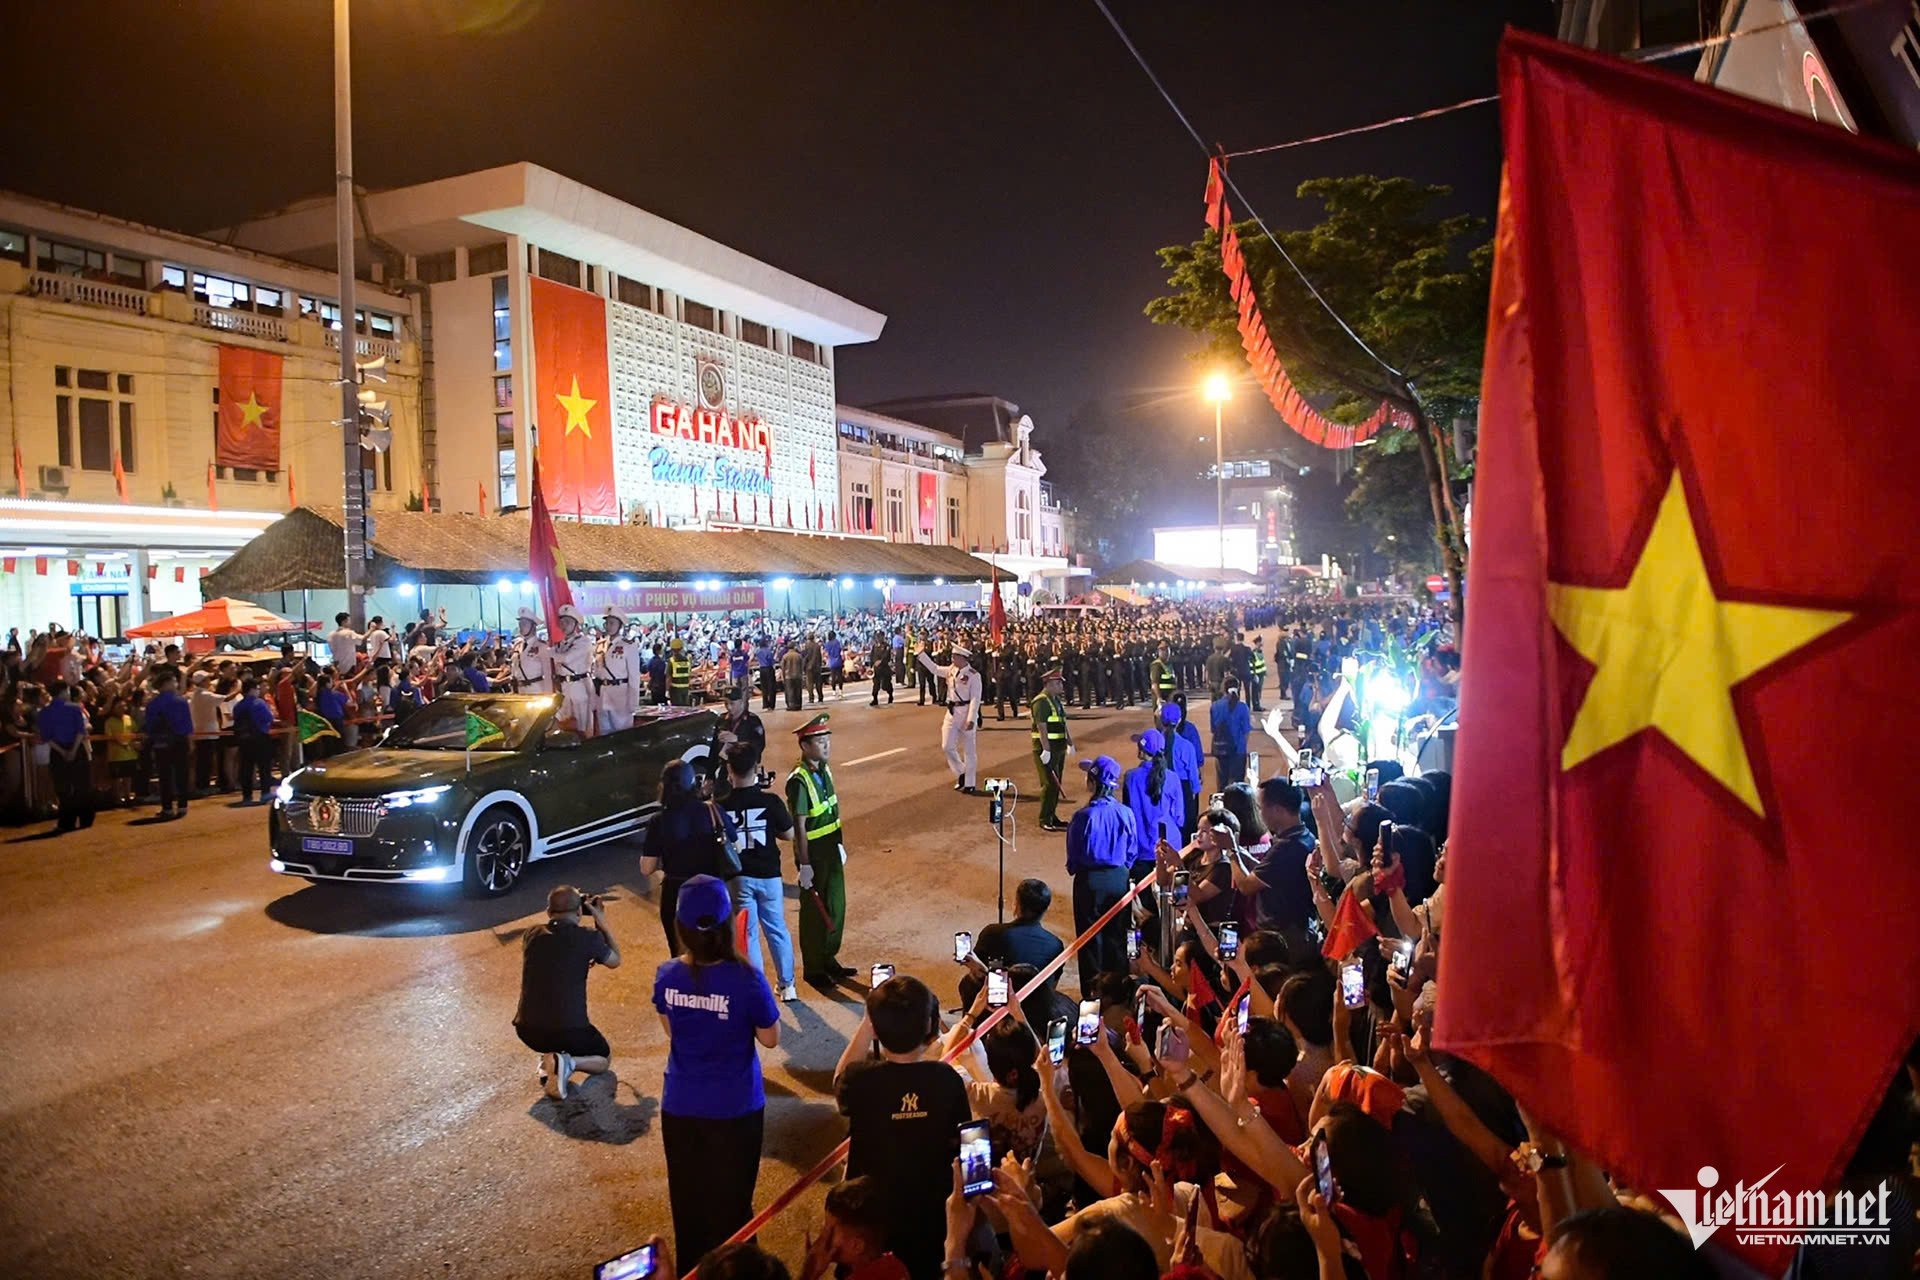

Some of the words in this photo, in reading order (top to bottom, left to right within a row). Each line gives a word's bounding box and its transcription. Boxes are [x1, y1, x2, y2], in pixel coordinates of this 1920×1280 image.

[655, 402, 696, 438] GA
[648, 445, 706, 484] Hanoi
[712, 456, 773, 495] Station
[645, 592, 679, 608] PHỤC
[682, 592, 697, 609] VỤ
[664, 987, 730, 1013] Vinamilk
